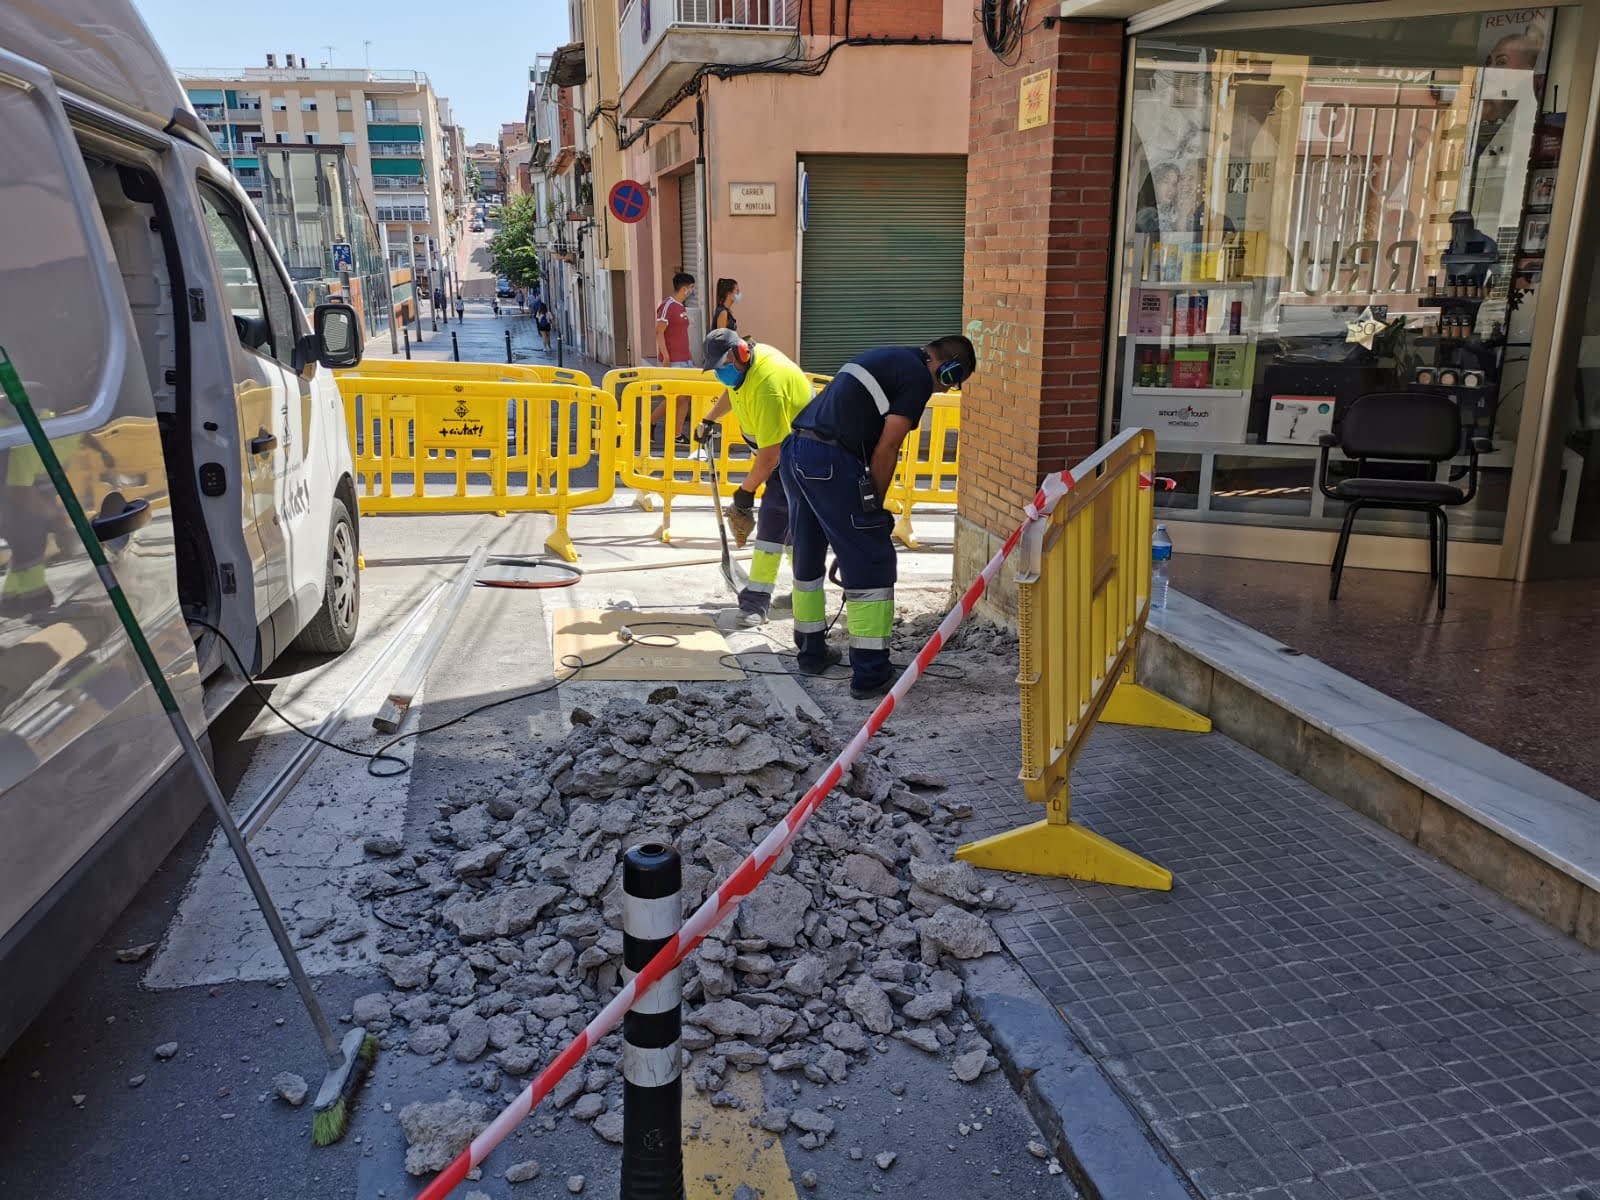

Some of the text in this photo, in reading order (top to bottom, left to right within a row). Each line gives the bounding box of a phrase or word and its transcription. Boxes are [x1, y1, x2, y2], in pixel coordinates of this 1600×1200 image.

[1486, 9, 1545, 28] REVLON
[1244, 161, 1270, 178] TIME
[741, 187, 764, 196] CARRER
[734, 202, 742, 211] DE
[1350, 319, 1376, 336] 50
